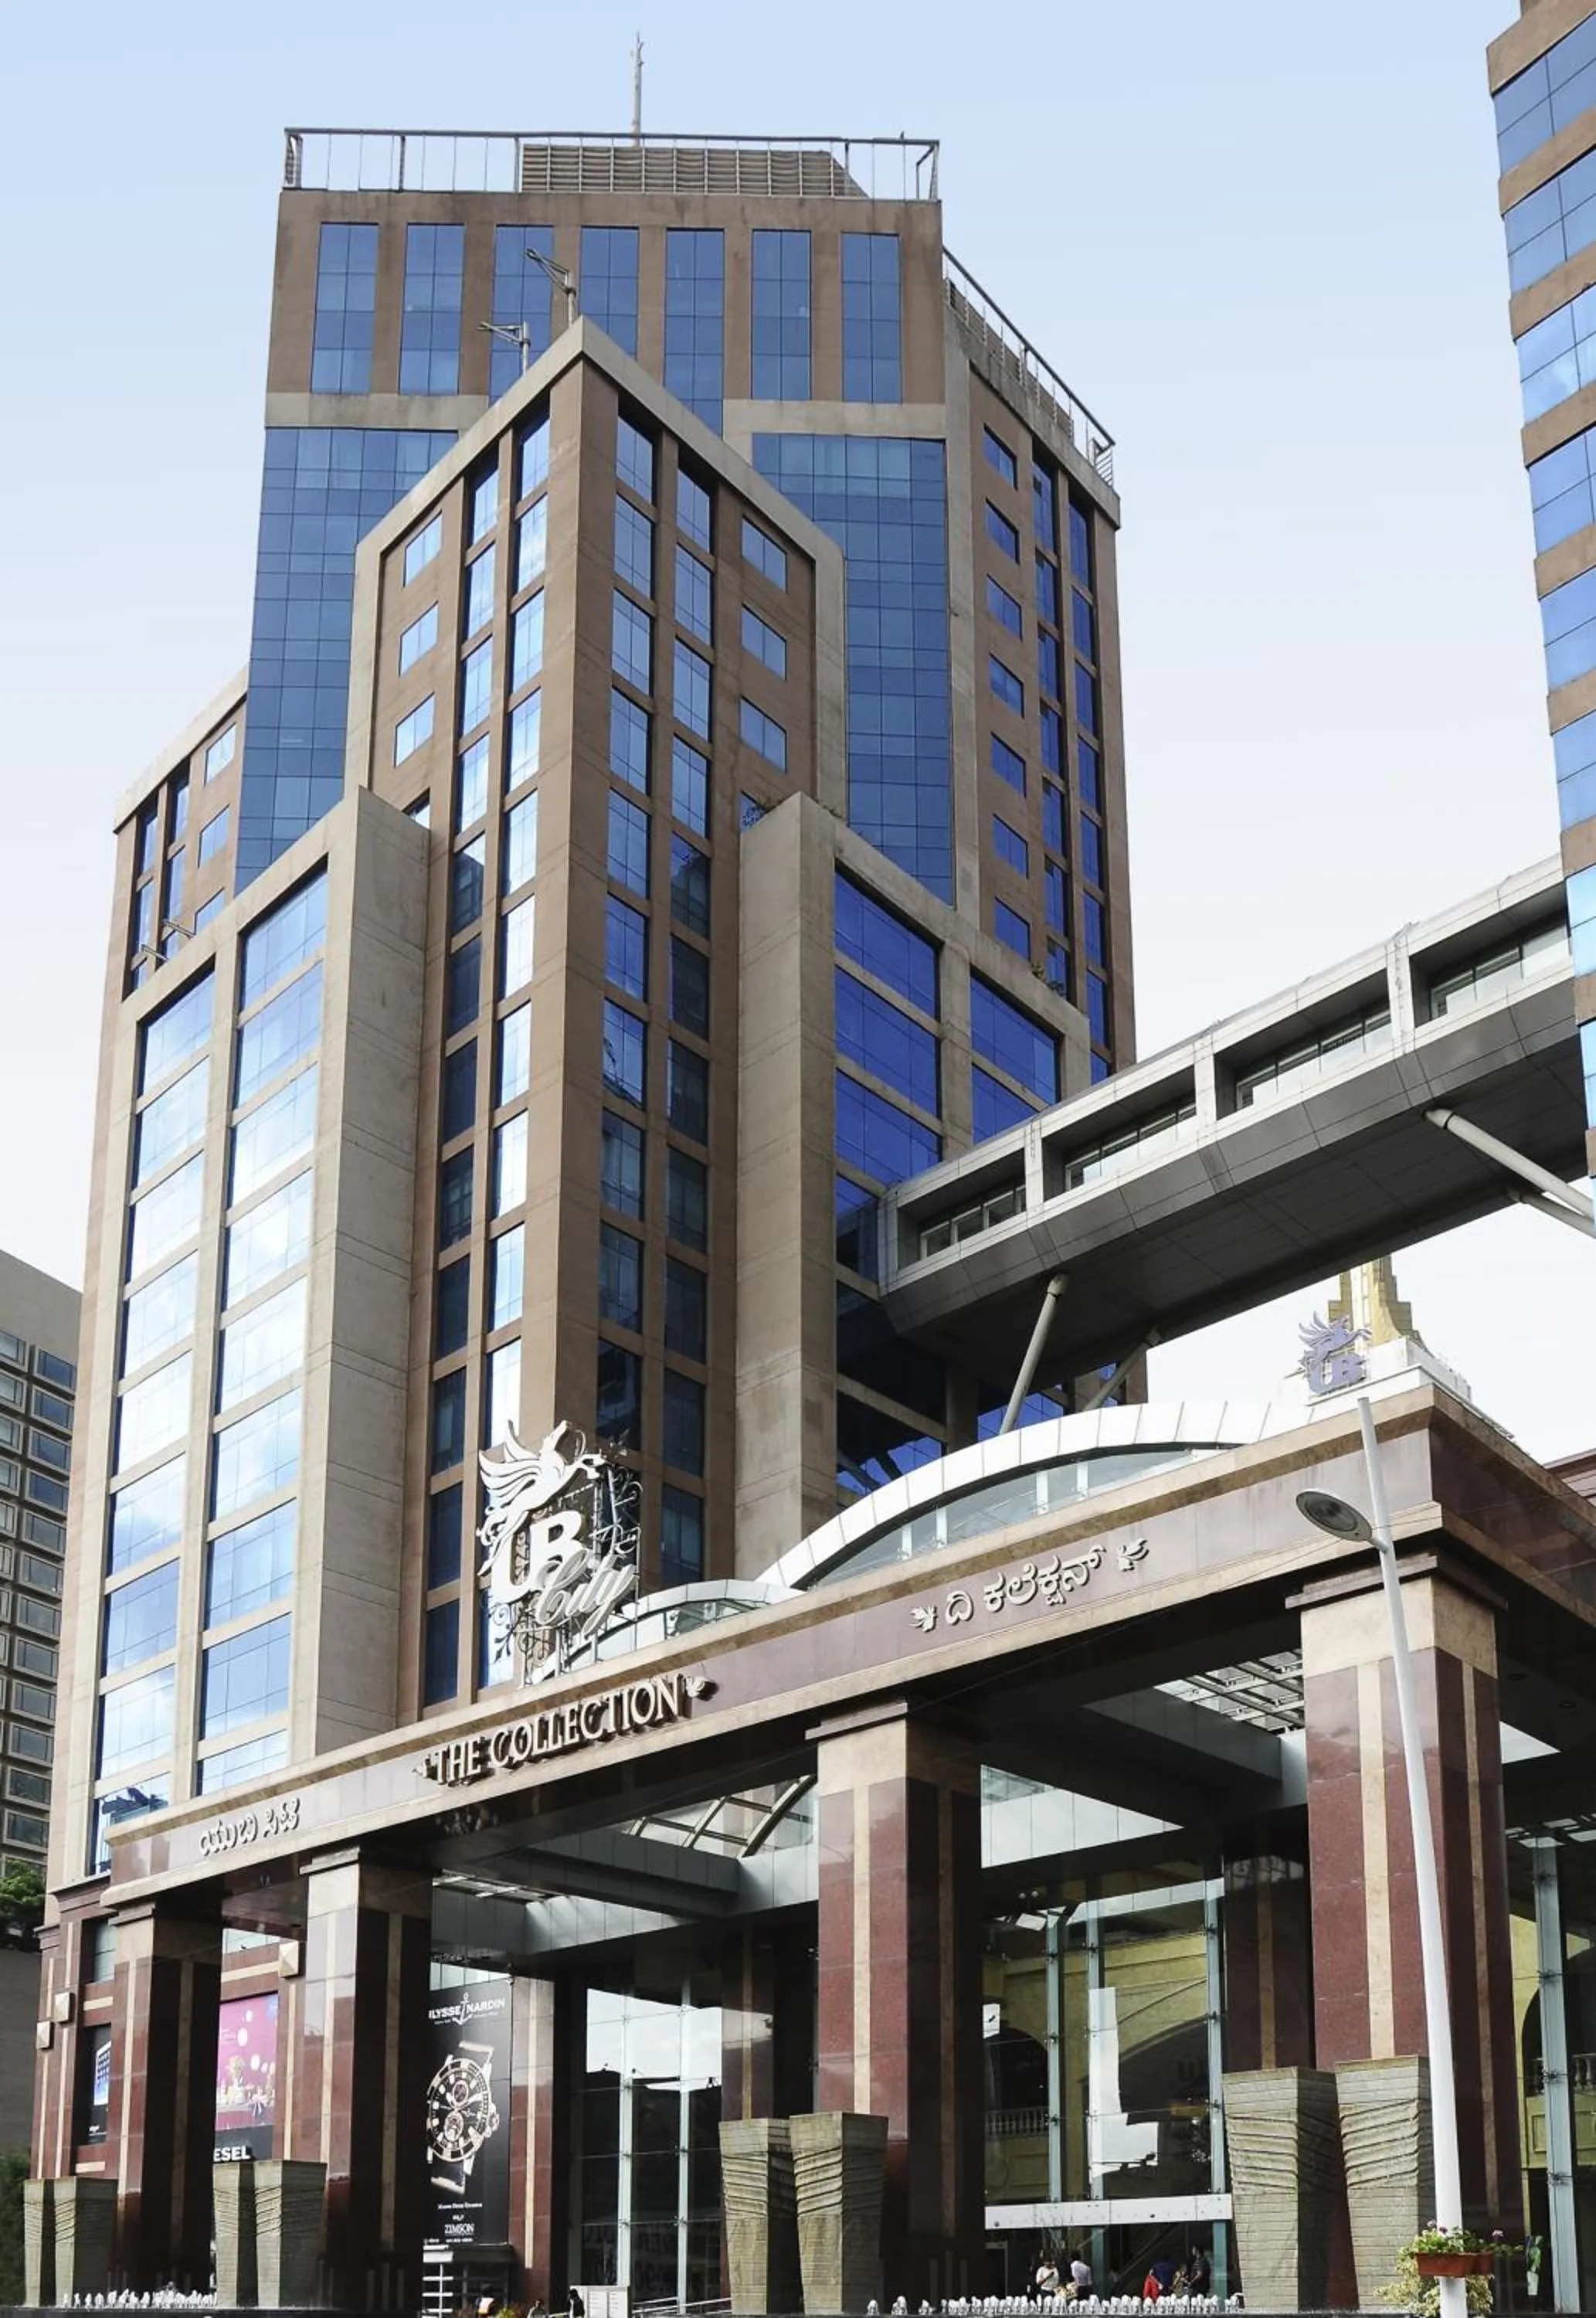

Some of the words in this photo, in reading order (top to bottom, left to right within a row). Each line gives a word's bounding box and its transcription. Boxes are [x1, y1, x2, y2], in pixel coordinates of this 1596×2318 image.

[1308, 1351, 1366, 1394] UB
[535, 1548, 635, 1637] City
[945, 1590, 975, 1626] ದಿ
[434, 1737, 484, 1785] THE
[490, 1673, 681, 1768] COLLECTION
